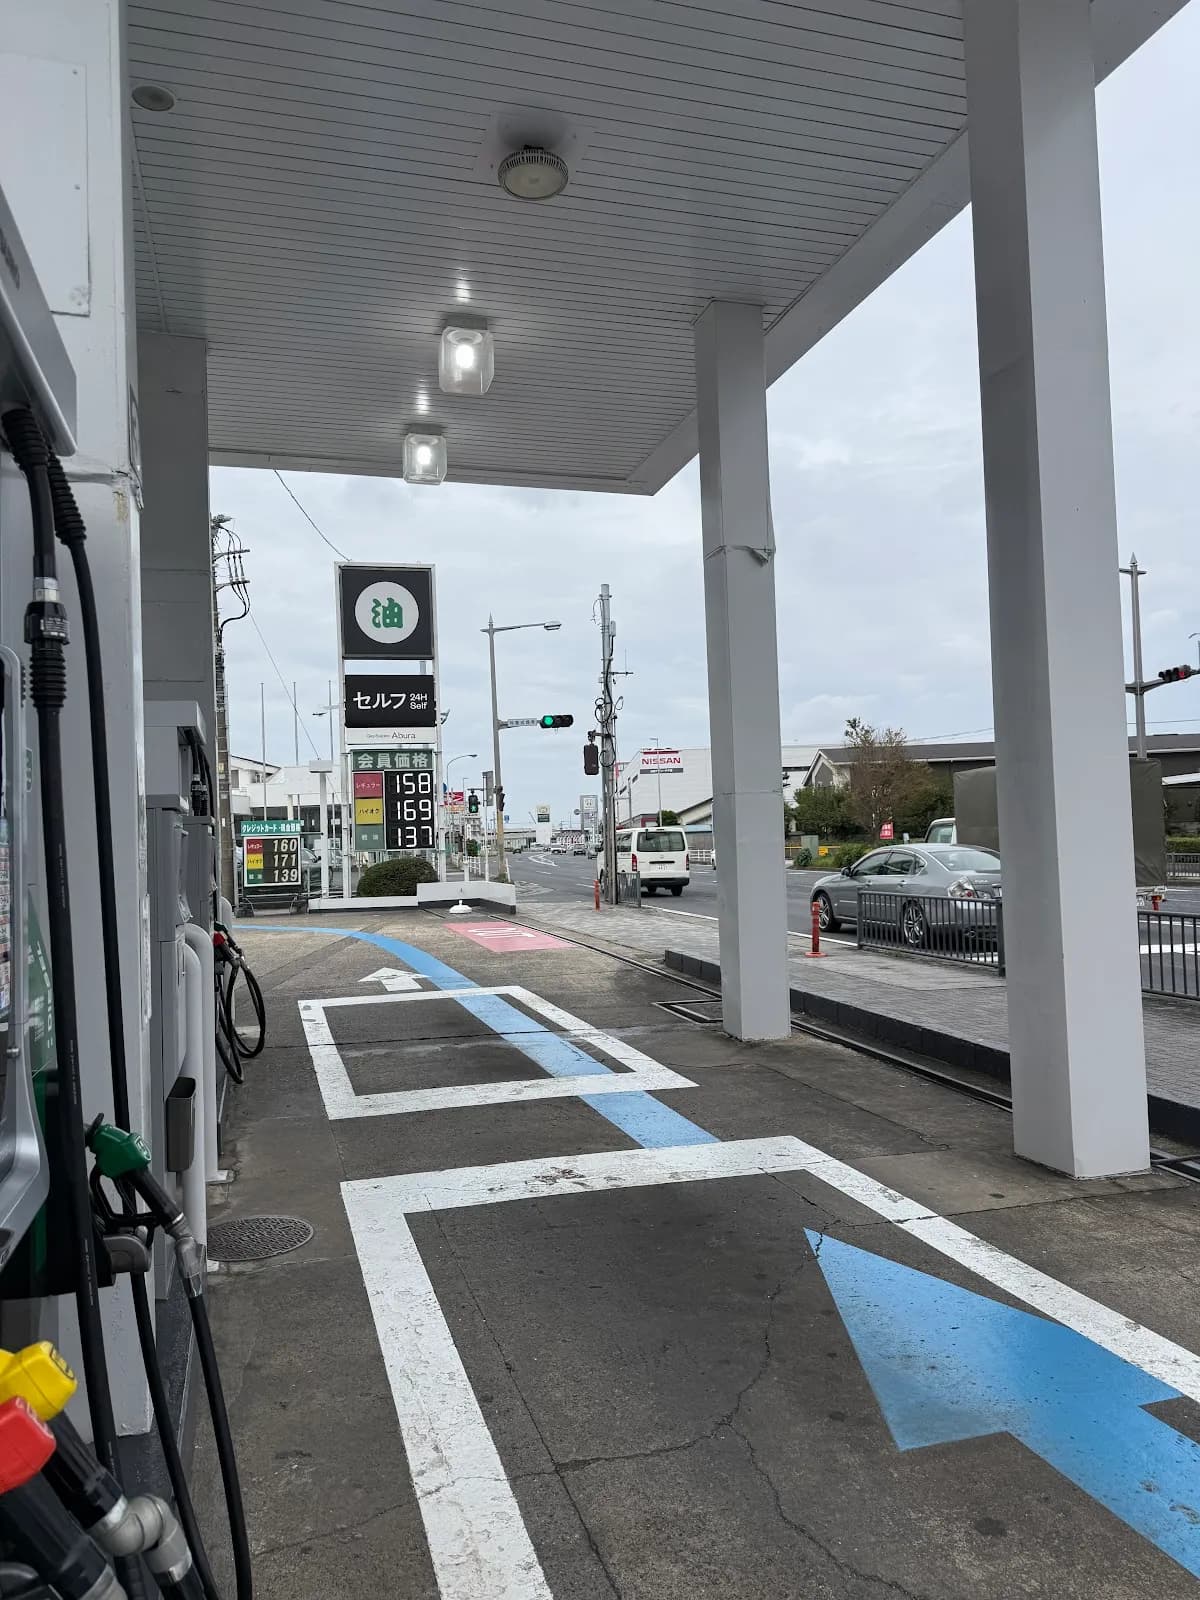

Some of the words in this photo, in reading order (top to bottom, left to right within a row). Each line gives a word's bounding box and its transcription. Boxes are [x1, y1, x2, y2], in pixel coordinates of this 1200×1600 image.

[371, 597, 404, 629] 油
[352, 691, 407, 710] セルフ
[409, 692, 428, 701] 24H
[409, 701, 428, 710] Self
[391, 731, 416, 739] Abura
[357, 752, 429, 769] 会員価格
[641, 757, 681, 765] NISSAN
[396, 772, 432, 794] 158
[397, 799, 433, 821] 169
[397, 825, 434, 848] 137
[273, 839, 298, 852] 160
[273, 854, 297, 867] 171
[273, 869, 298, 882] 139
